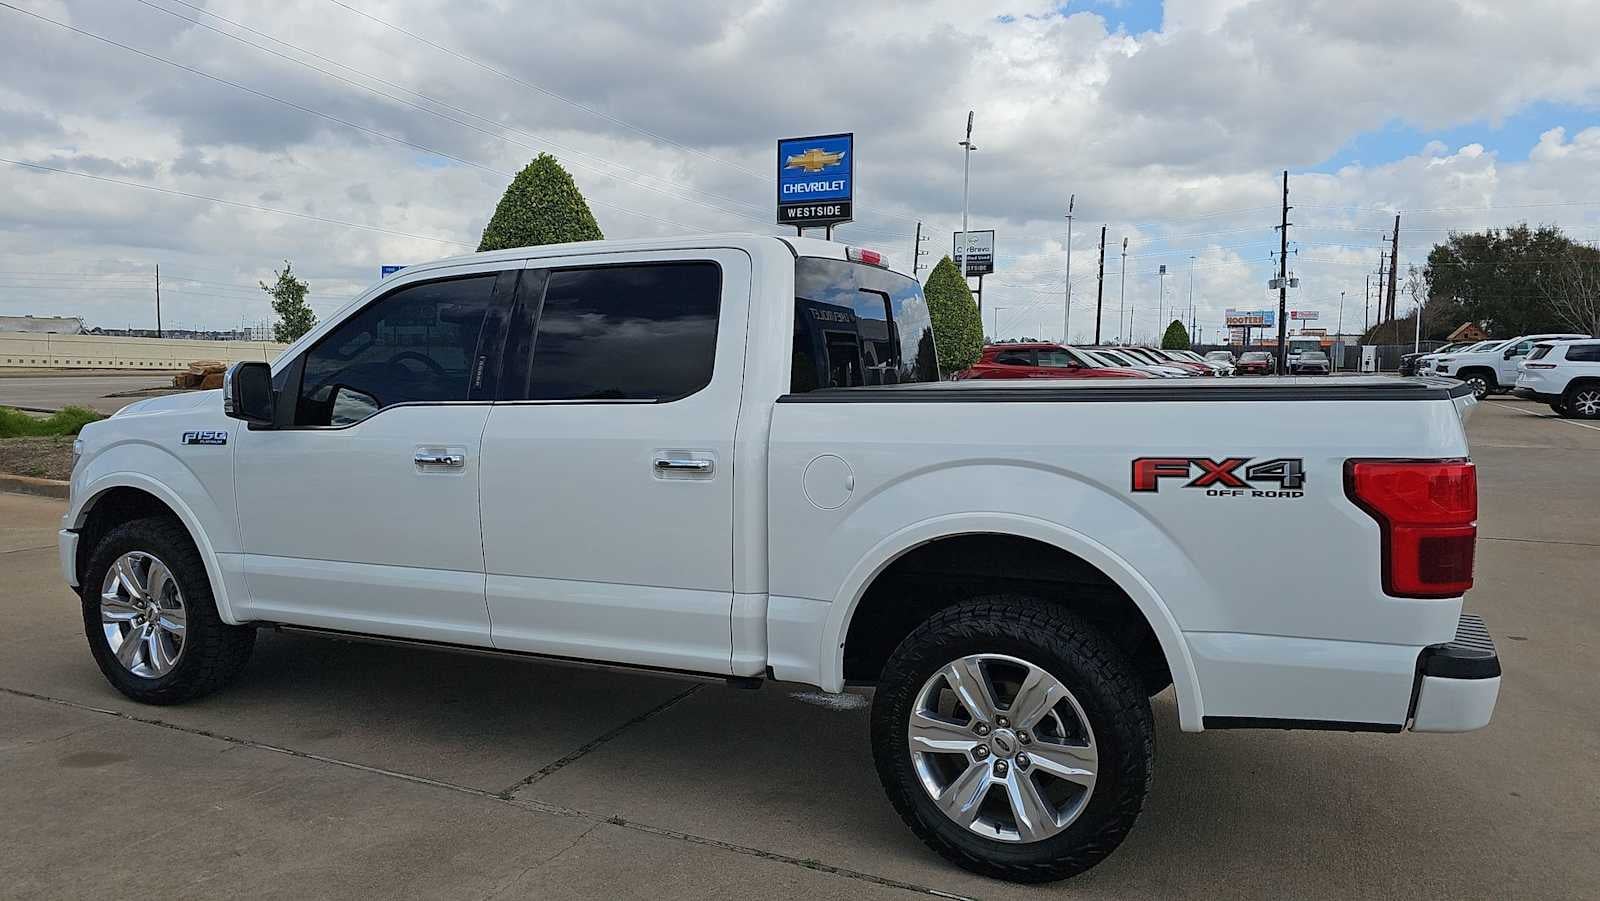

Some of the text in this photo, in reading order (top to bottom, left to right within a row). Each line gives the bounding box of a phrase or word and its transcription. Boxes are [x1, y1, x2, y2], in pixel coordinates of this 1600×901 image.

[783, 180, 846, 193] CHEVROLET
[787, 205, 841, 217] WESTSIDE
[1226, 316, 1264, 324] HOOTERS
[1131, 457, 1306, 492] FX4
[1206, 489, 1304, 498] OFF ROAD
